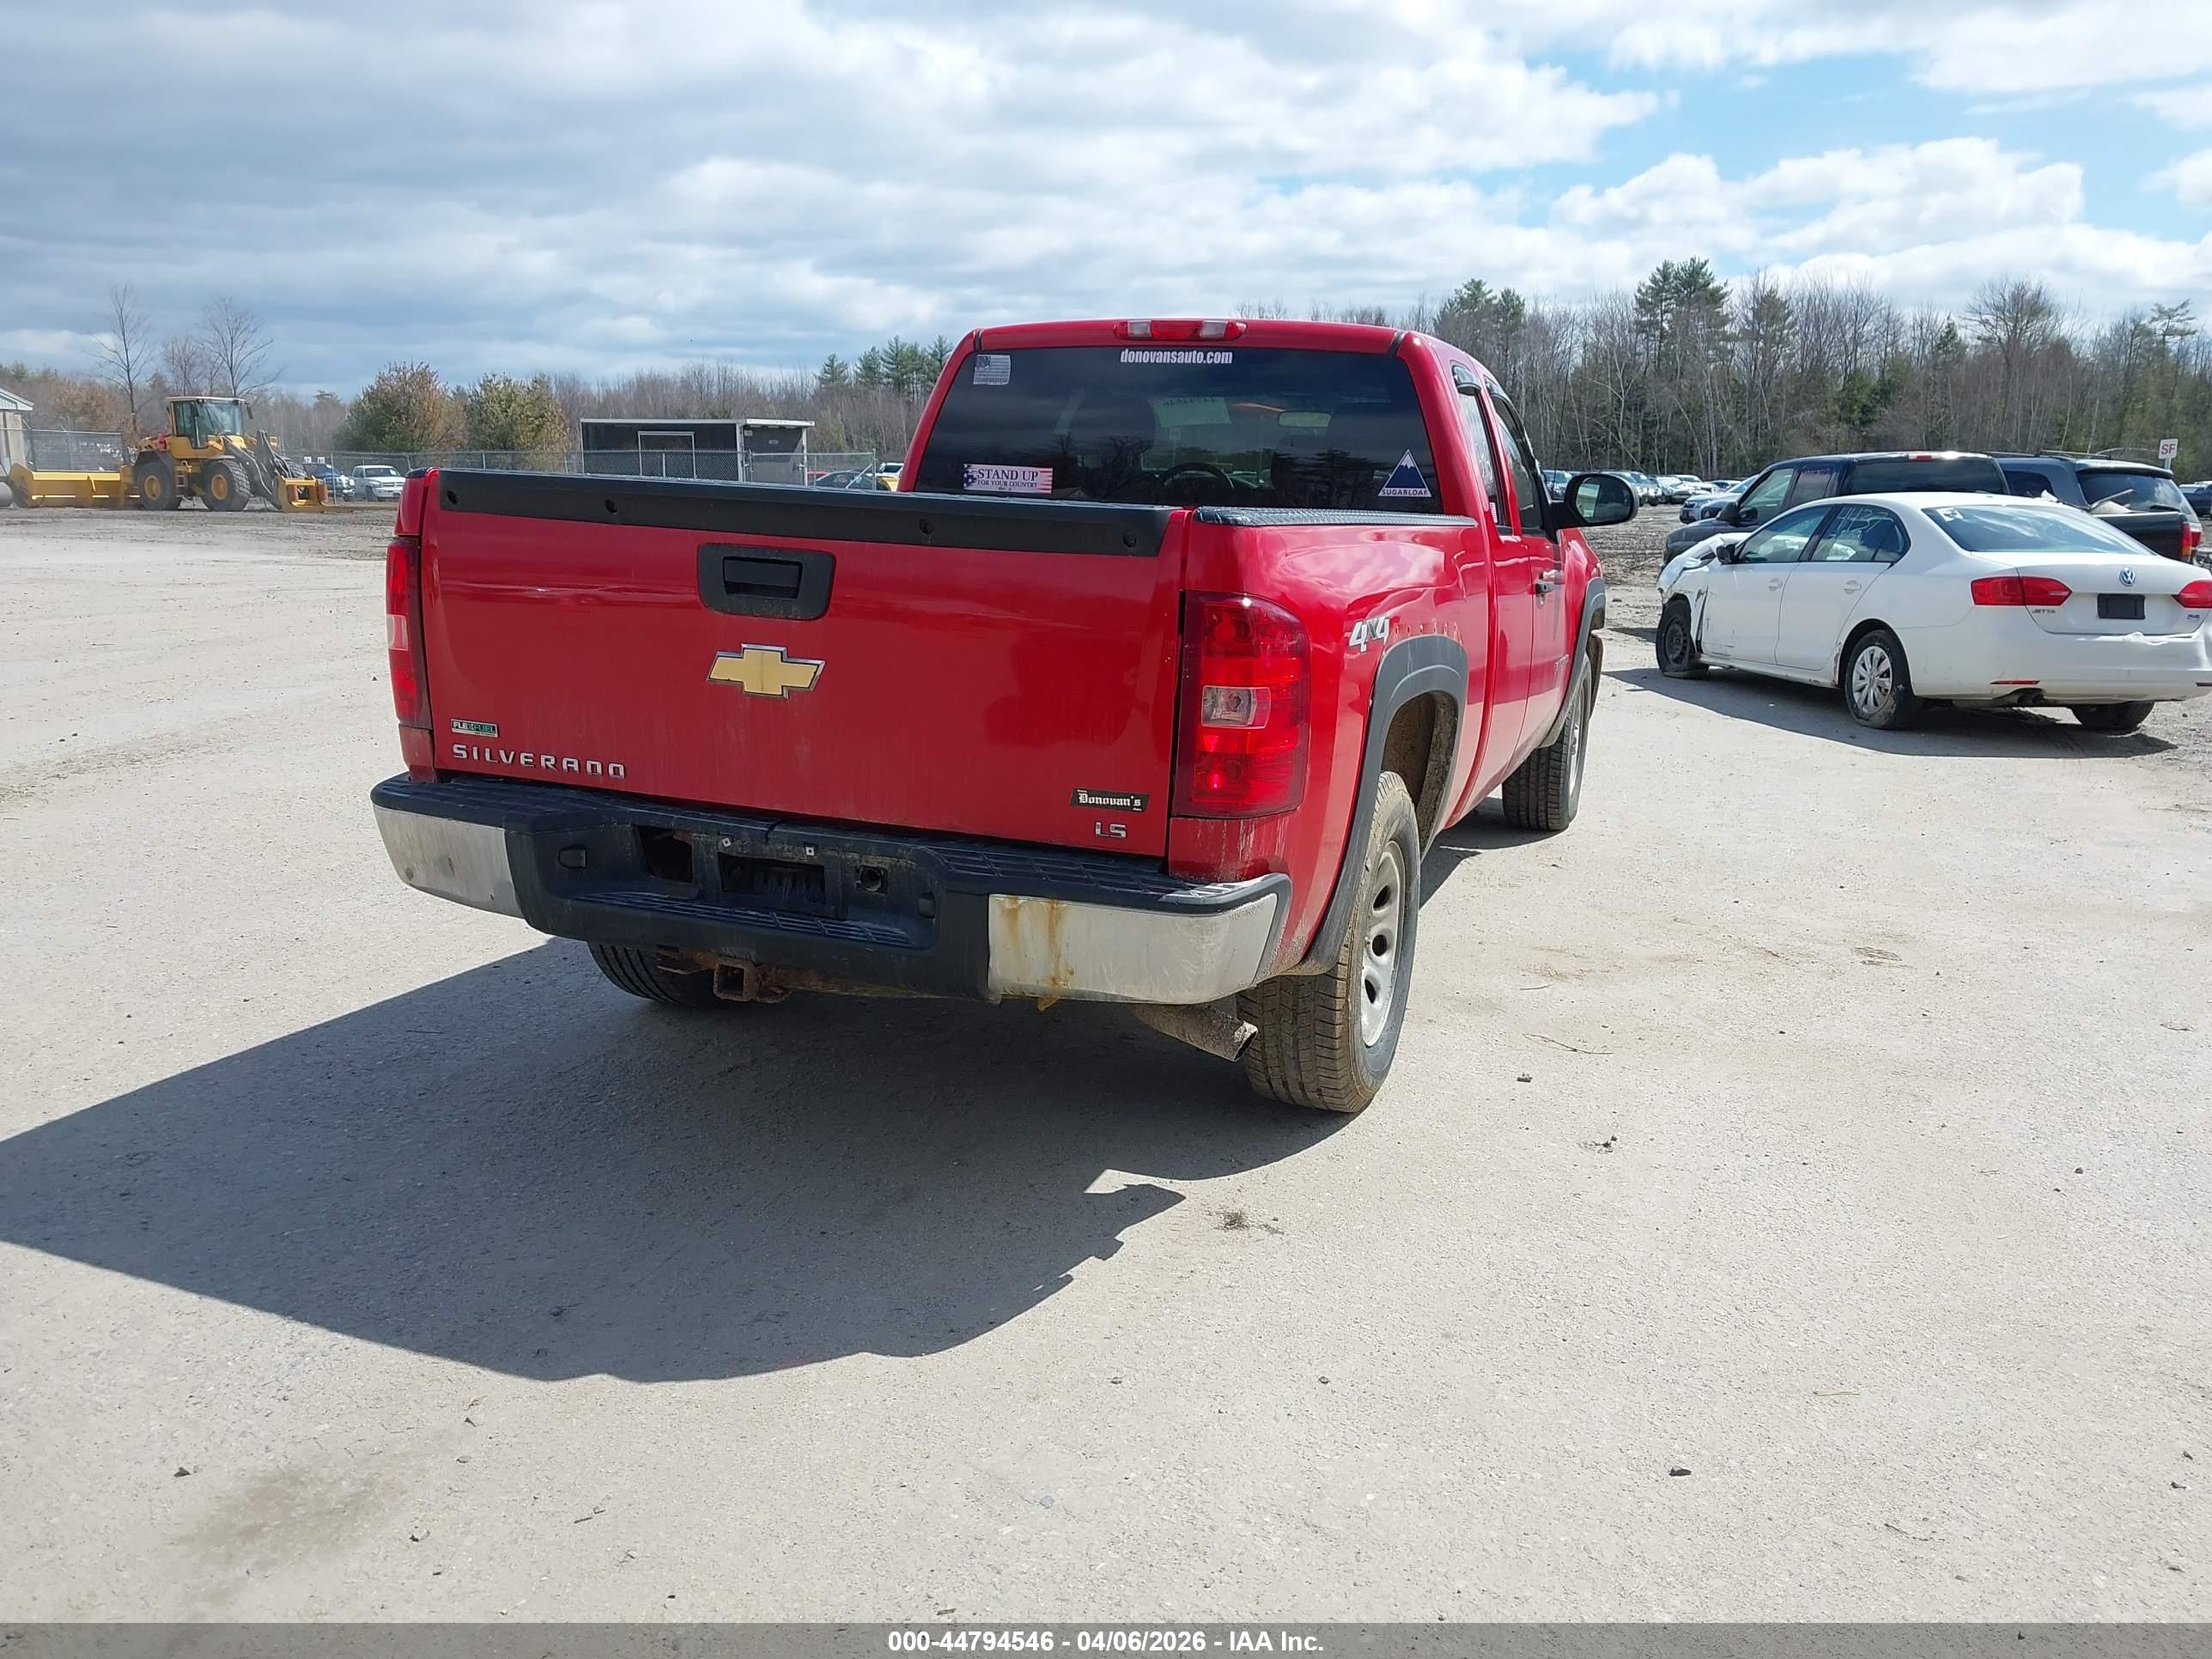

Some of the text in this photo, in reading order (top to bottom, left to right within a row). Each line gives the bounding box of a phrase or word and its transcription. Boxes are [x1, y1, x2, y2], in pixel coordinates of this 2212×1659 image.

[1121, 349, 1232, 364] donovansauto.com
[2161, 443, 2176, 454] SF
[977, 468, 1038, 482] STAND UP
[453, 744, 625, 779] SILVERADO
[1078, 793, 1141, 806] Donovan's
[1096, 822, 1127, 839] LS
